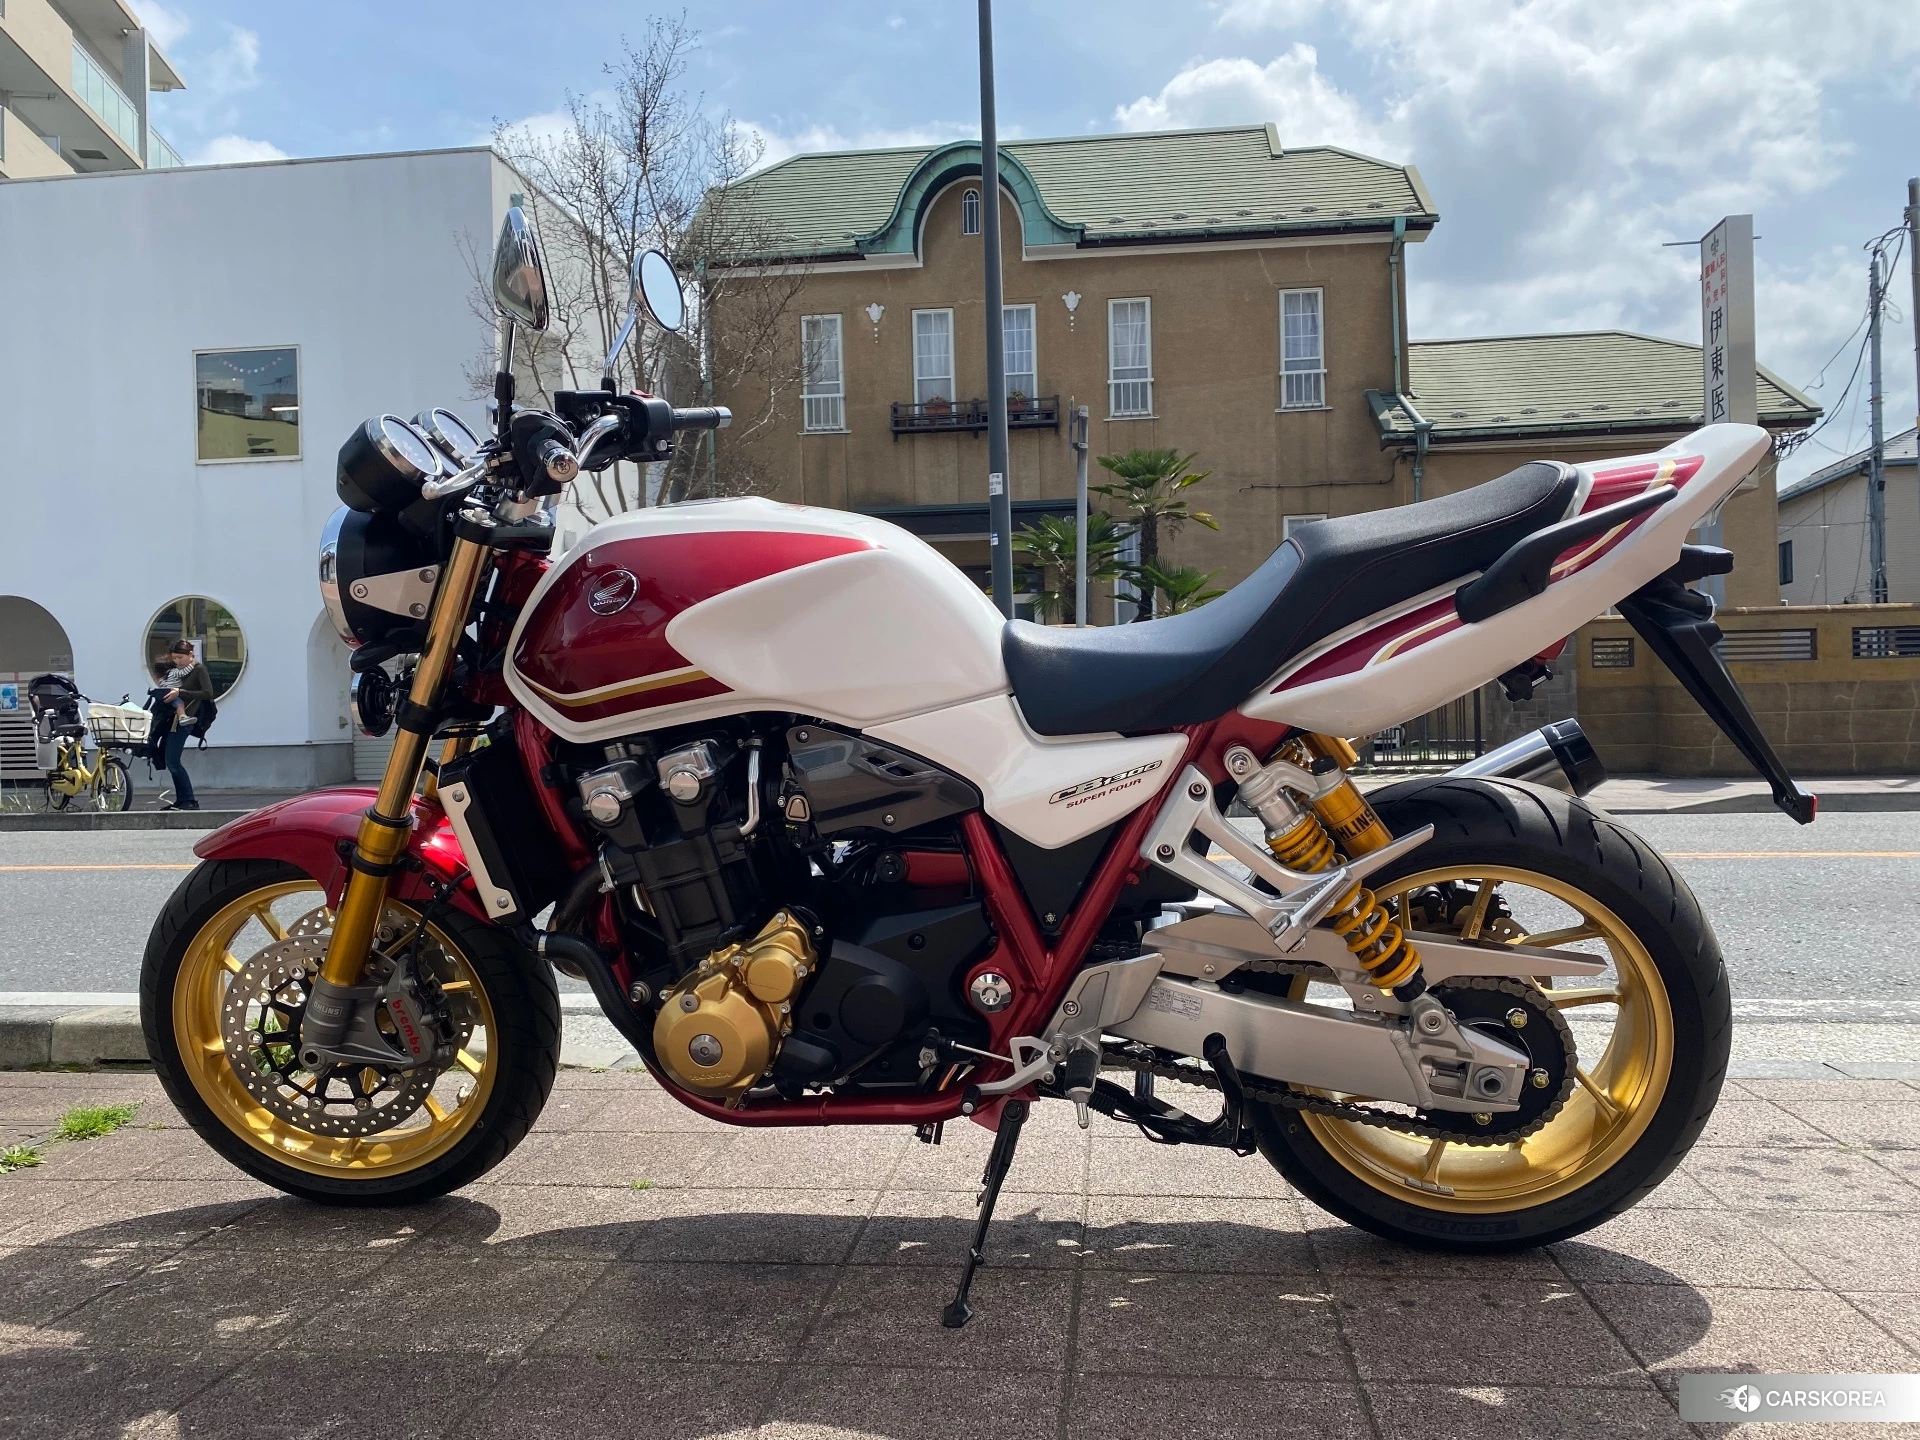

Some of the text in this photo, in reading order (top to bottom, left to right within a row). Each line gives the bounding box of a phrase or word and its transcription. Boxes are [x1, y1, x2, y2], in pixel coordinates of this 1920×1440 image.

[1066, 778, 1142, 808] SUPER FOUR
[1335, 808, 1376, 840] HLINS
[392, 999, 420, 1055] brembo
